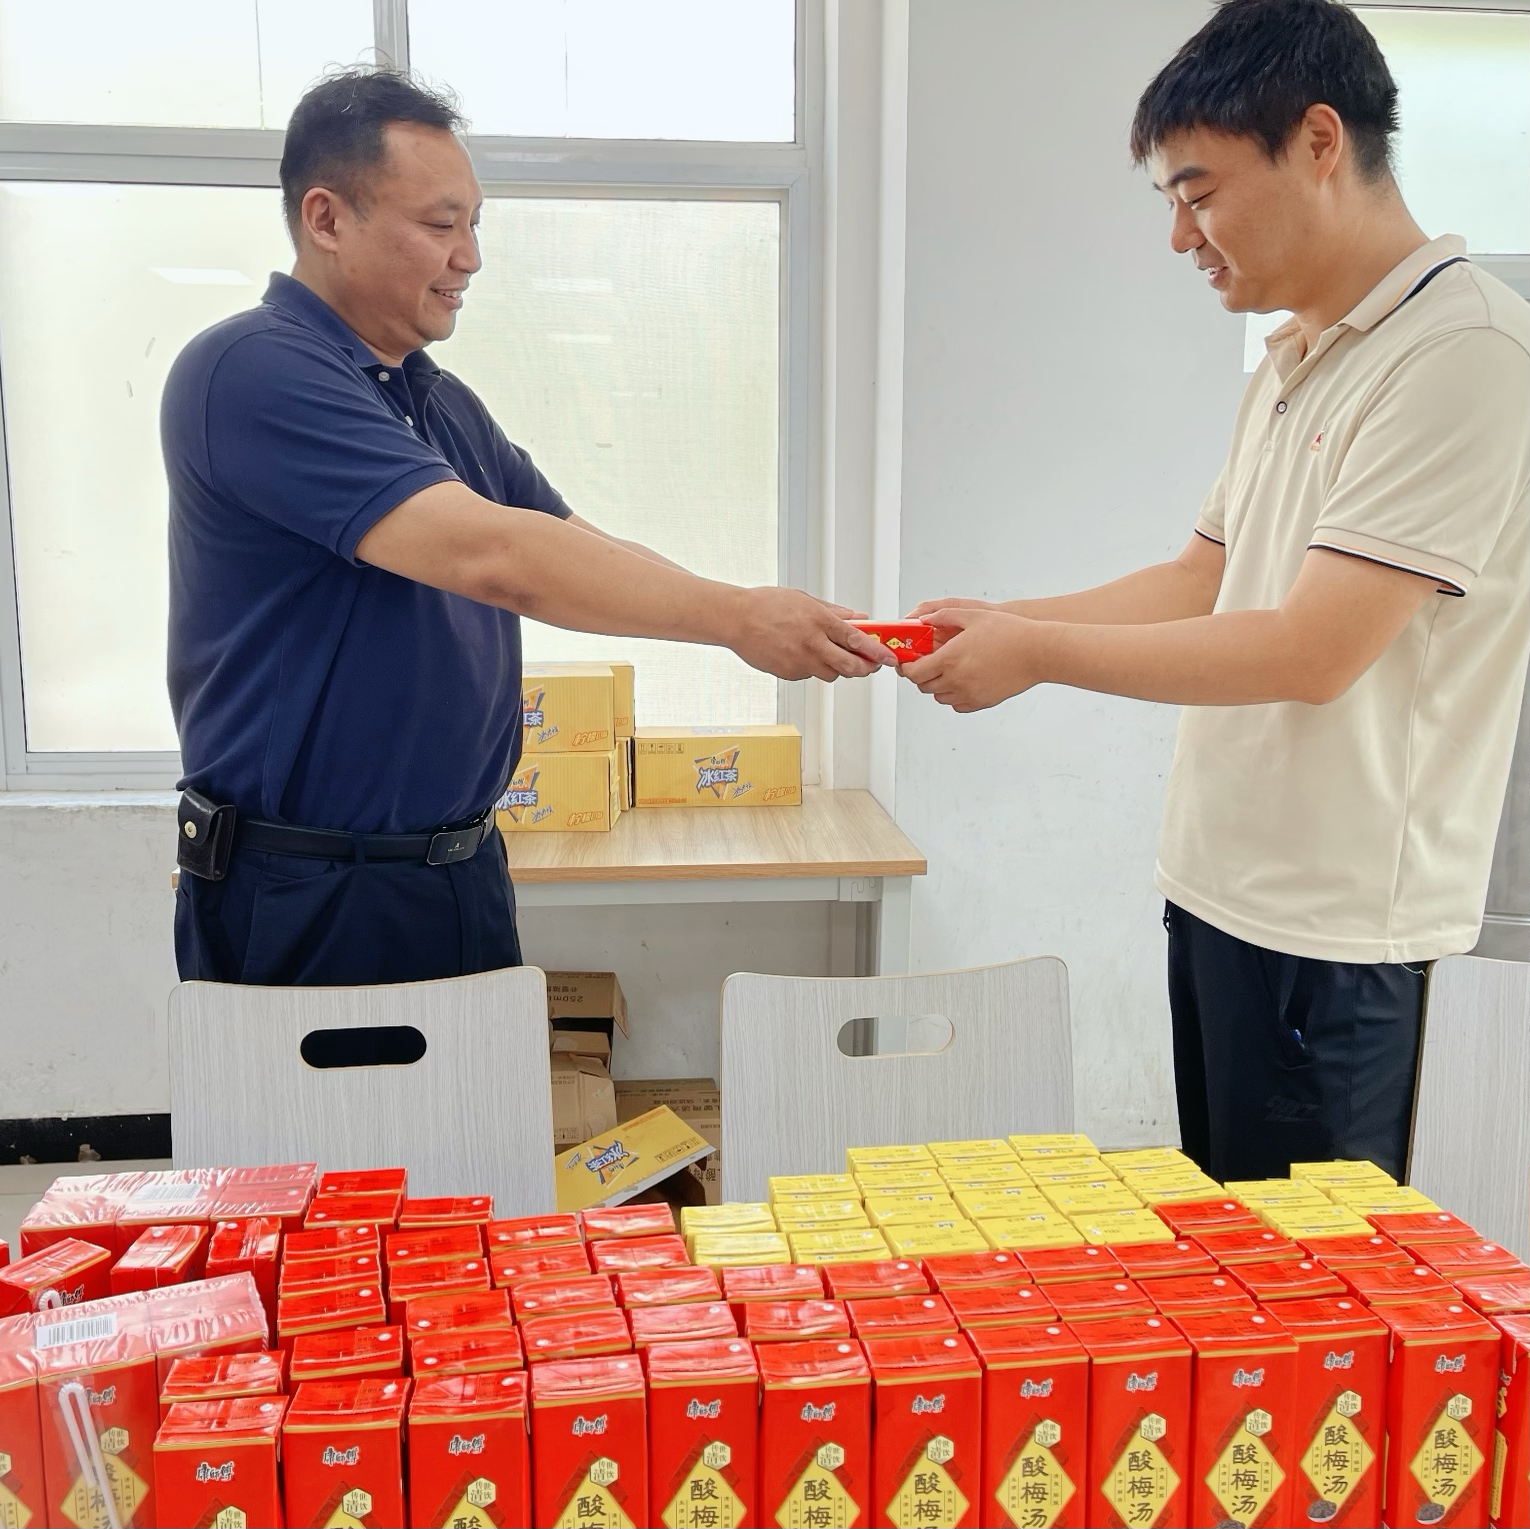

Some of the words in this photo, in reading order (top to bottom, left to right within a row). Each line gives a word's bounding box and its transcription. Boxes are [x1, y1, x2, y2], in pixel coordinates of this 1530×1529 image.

[697, 767, 739, 792] 冰红茶
[1020, 1455, 1049, 1529] 酸梅汤
[1126, 1449, 1155, 1524] 酸梅汤
[1230, 1443, 1260, 1514] 酸梅汤
[1322, 1424, 1350, 1495] 酸梅汤
[1432, 1428, 1460, 1497] 酸梅汤
[913, 1472, 943, 1529] 酸梅
